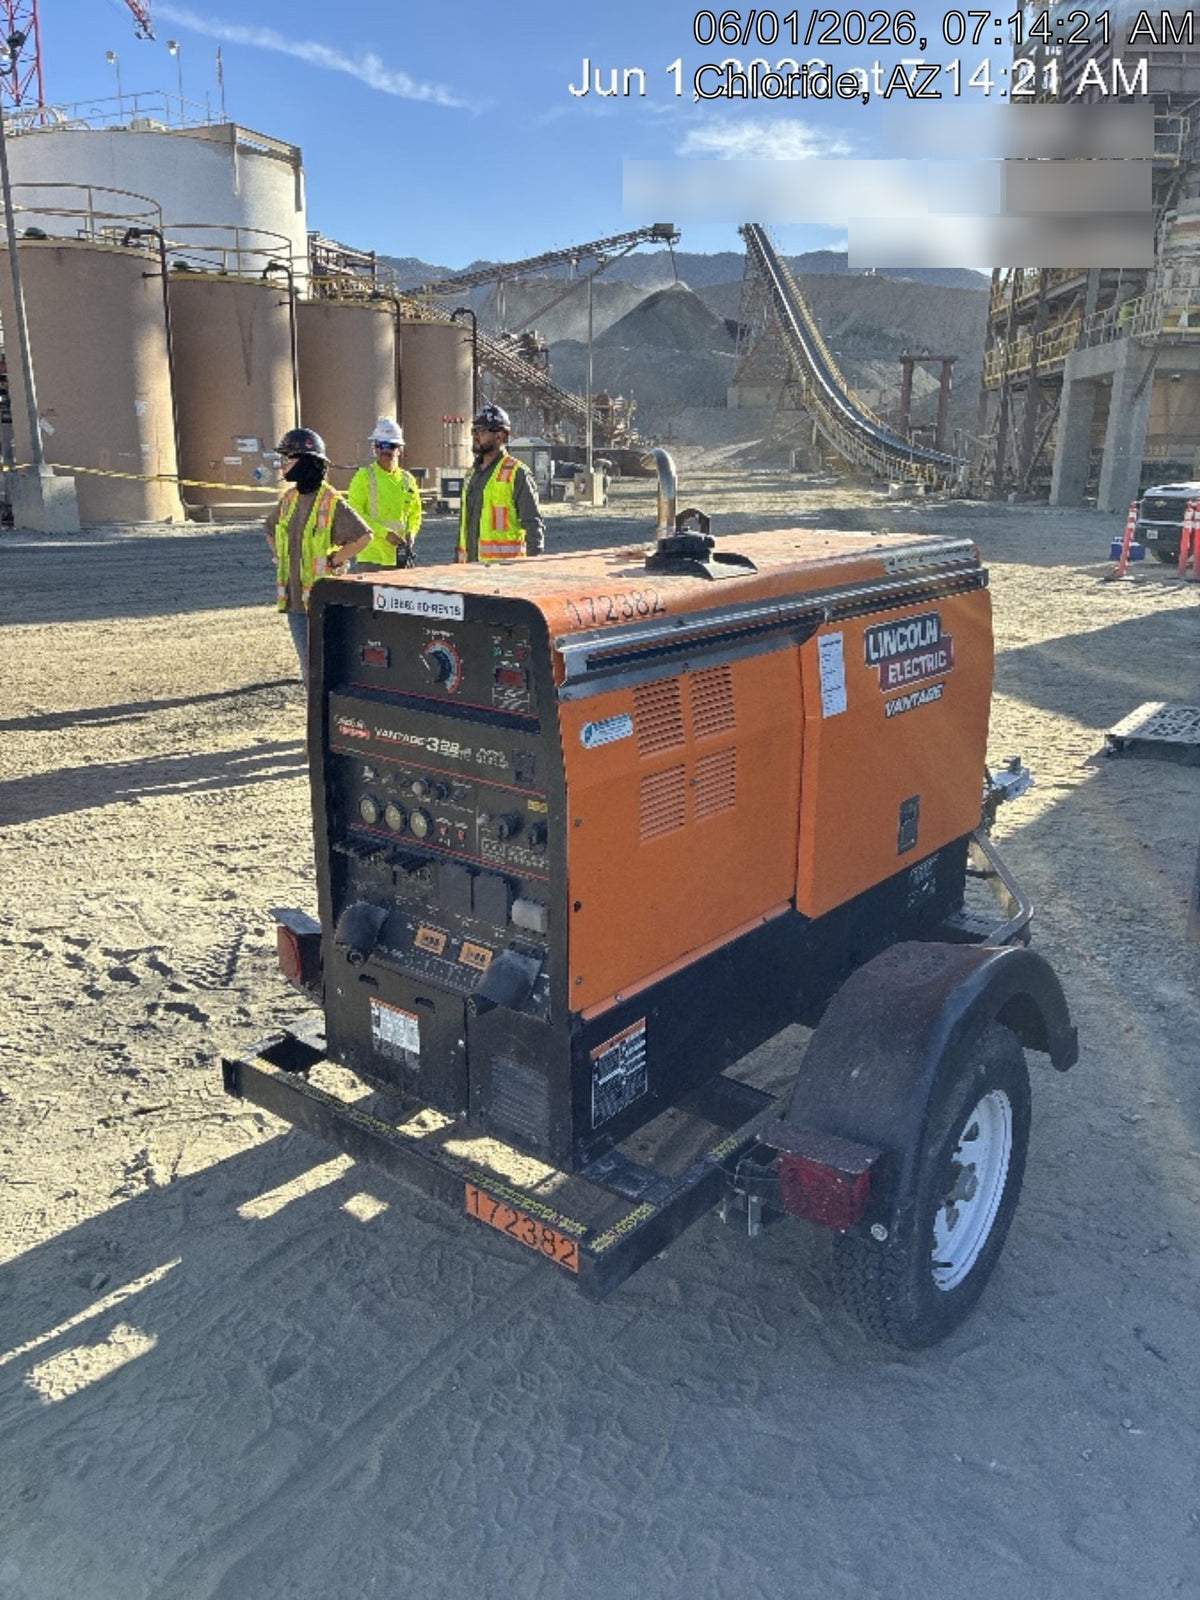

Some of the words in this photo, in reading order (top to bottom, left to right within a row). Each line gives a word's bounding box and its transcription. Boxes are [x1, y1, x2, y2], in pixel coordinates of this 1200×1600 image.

[566, 588, 666, 625] 172382
[868, 617, 938, 661] LINCOLN
[888, 650, 948, 684] ELECTRIC
[885, 681, 946, 719] VANTAGE
[471, 1190, 576, 1270] 172382
